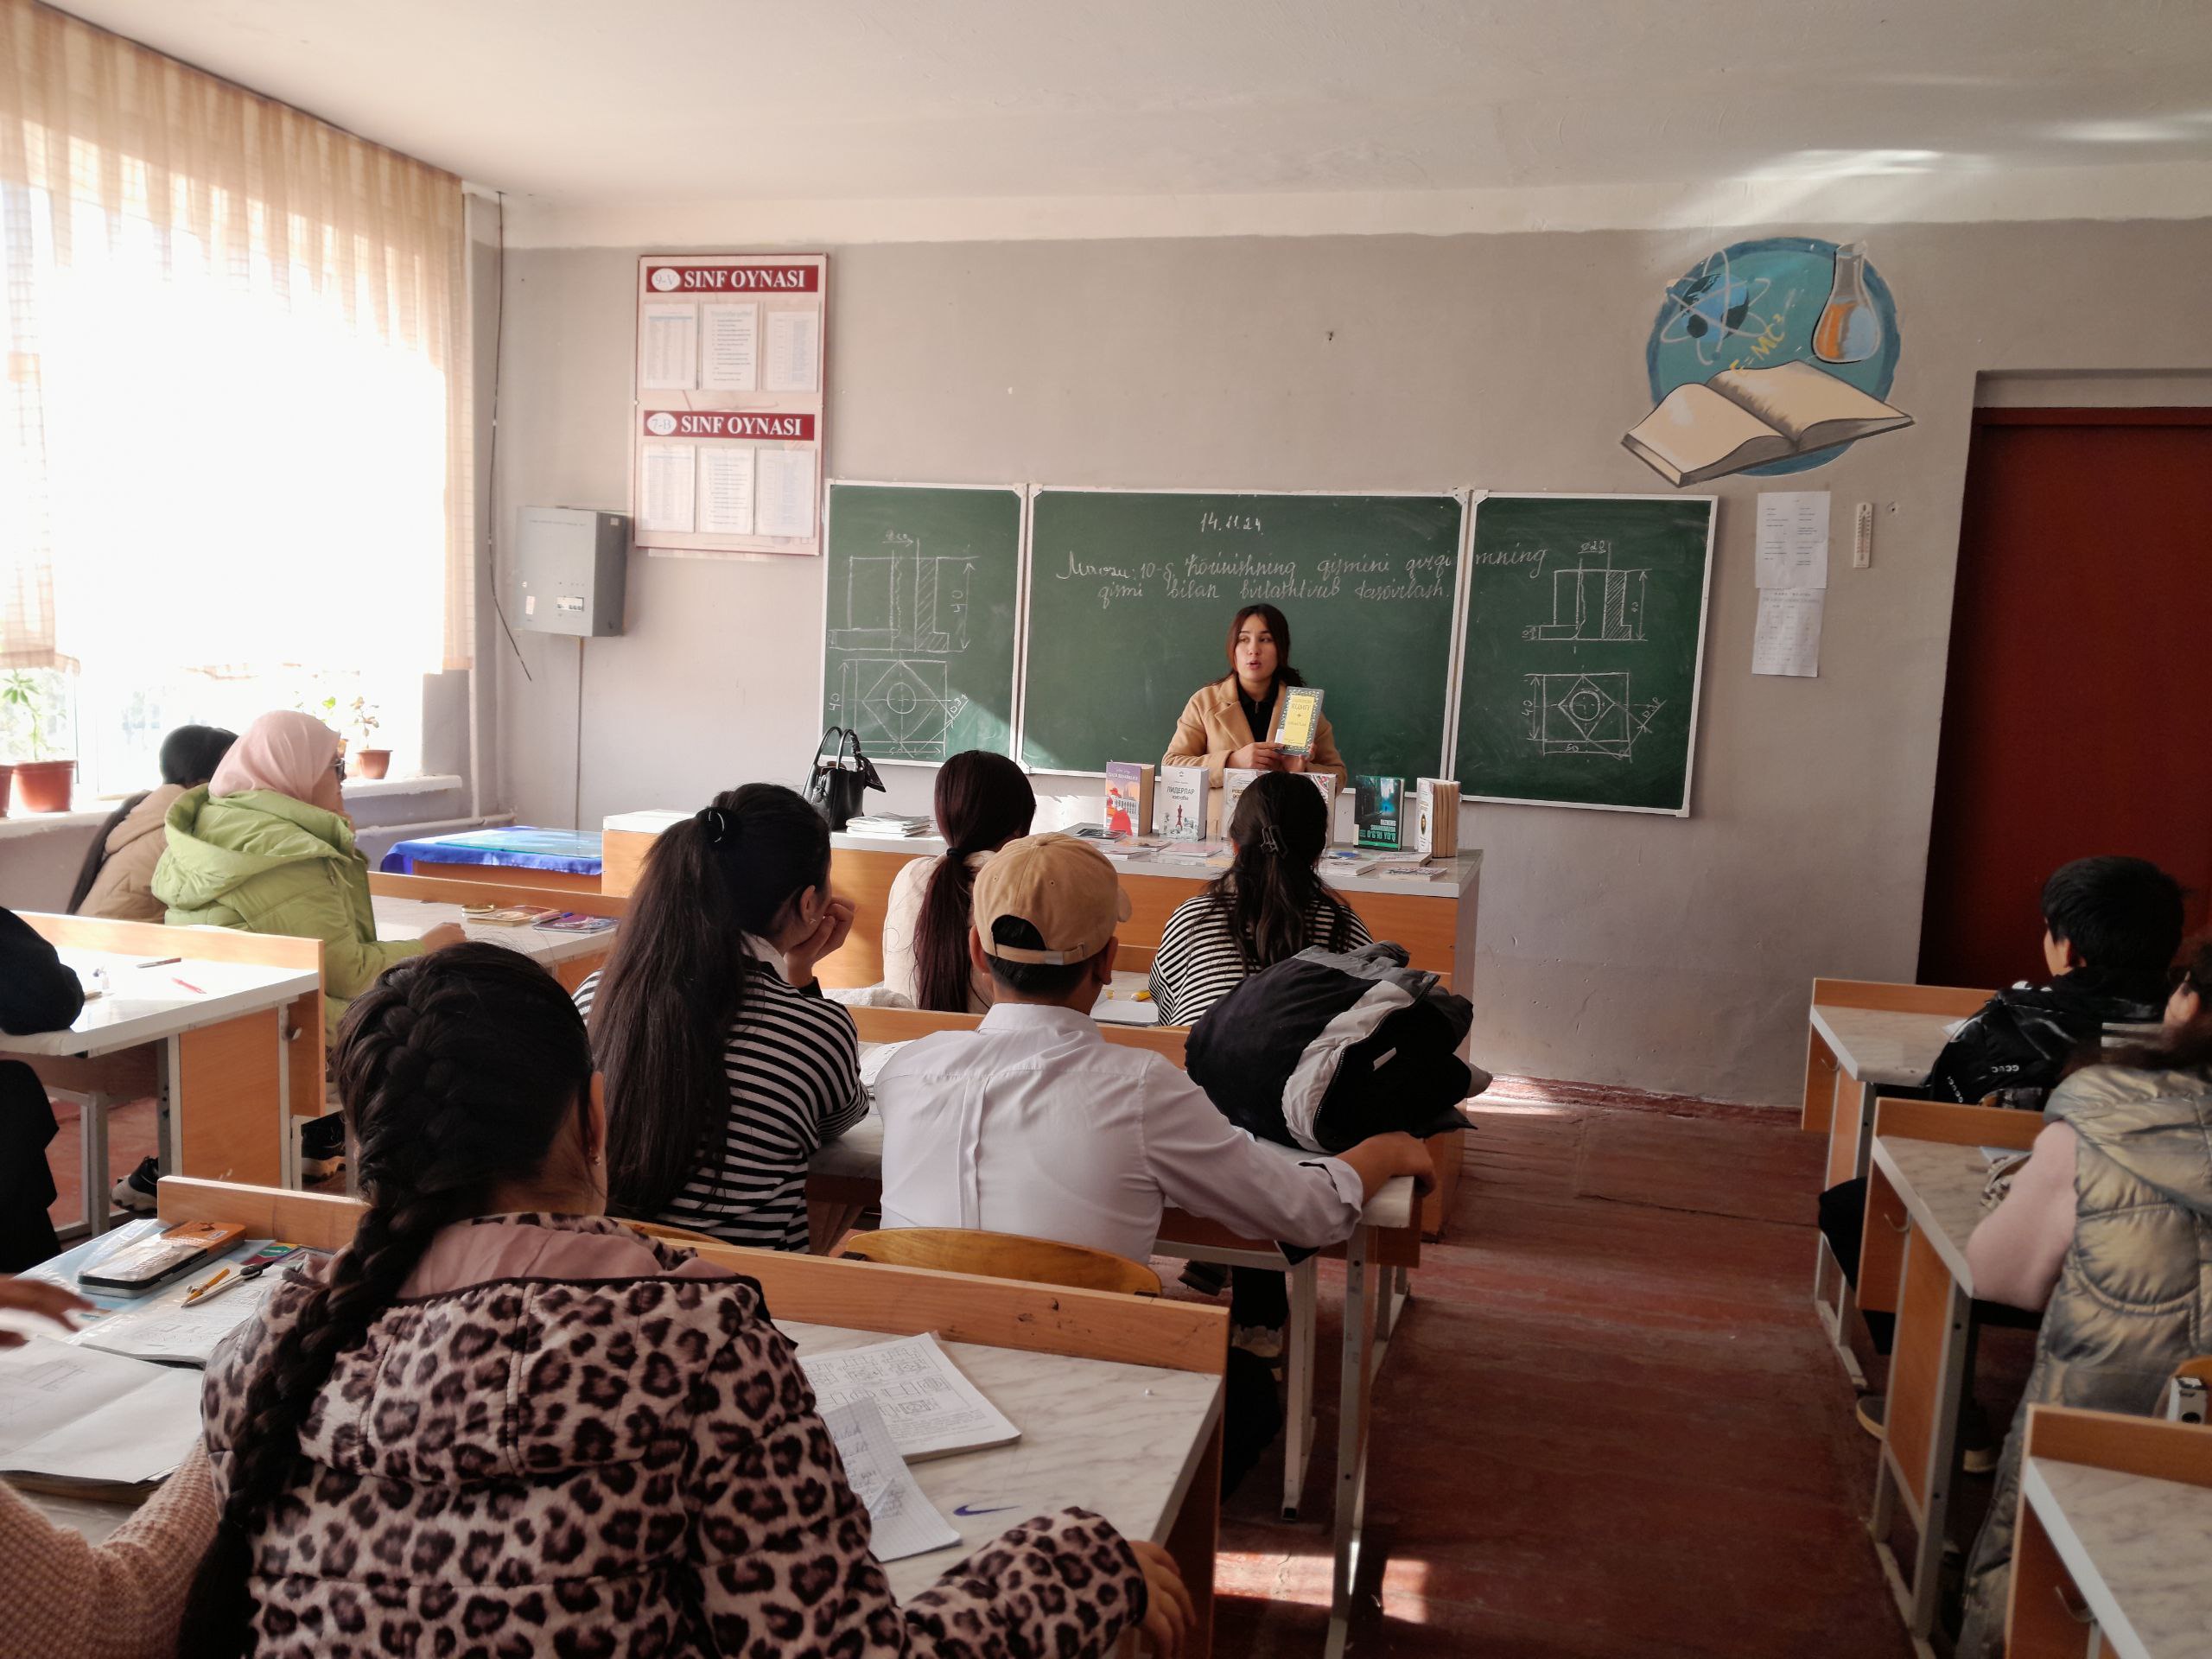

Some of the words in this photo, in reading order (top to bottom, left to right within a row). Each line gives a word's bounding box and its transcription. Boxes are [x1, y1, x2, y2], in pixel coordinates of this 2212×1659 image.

[683, 270, 728, 288] SINF
[730, 270, 805, 289] OYNASI
[681, 416, 724, 434] SINF
[728, 416, 802, 436] OYNASI
[1166, 578, 1220, 600] bilan
